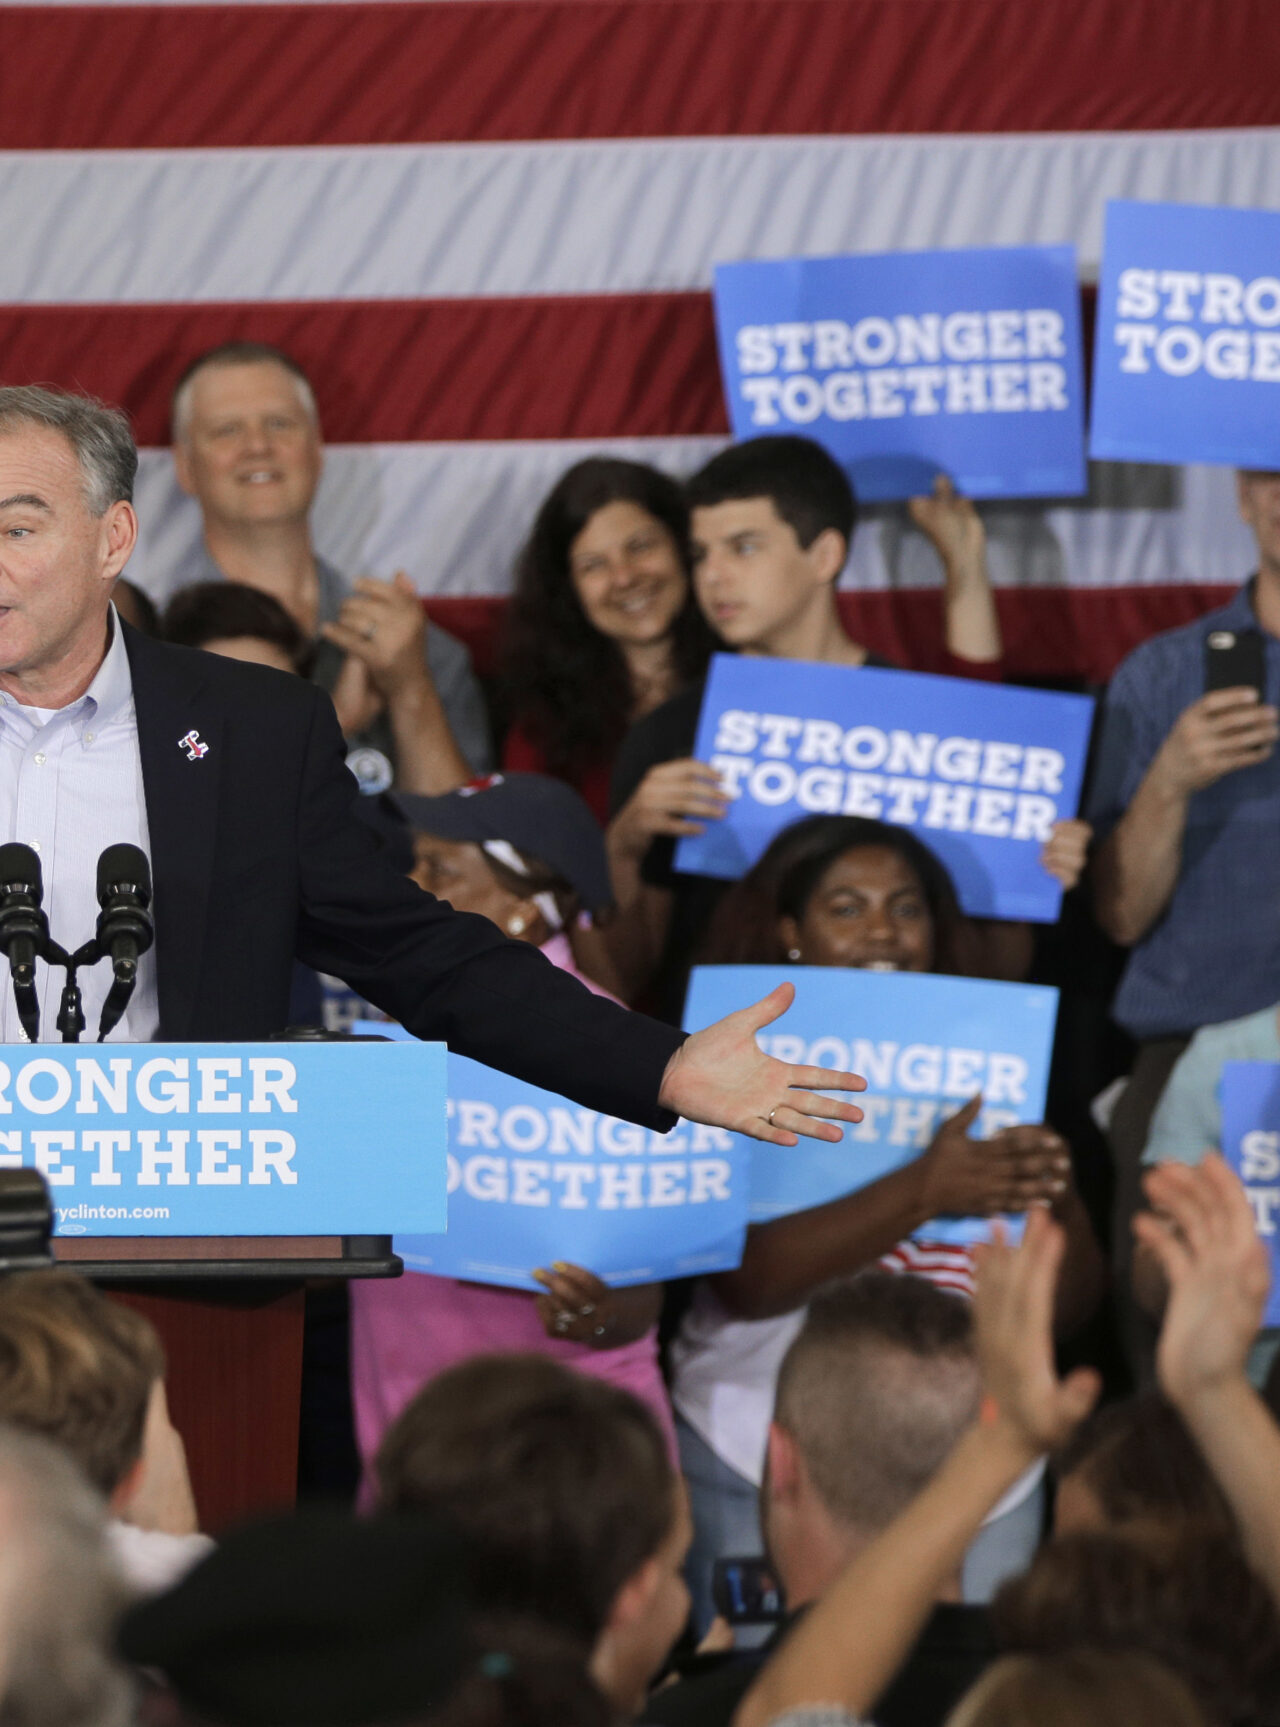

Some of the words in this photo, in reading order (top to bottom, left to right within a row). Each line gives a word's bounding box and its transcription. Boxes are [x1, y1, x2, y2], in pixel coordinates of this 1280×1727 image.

[737, 309, 1066, 374] STRONGER
[741, 363, 1069, 425] TOGETHER
[714, 709, 1065, 794] STRONGER
[710, 754, 1057, 842] TOGETHER
[447, 1098, 734, 1156] RONGER
